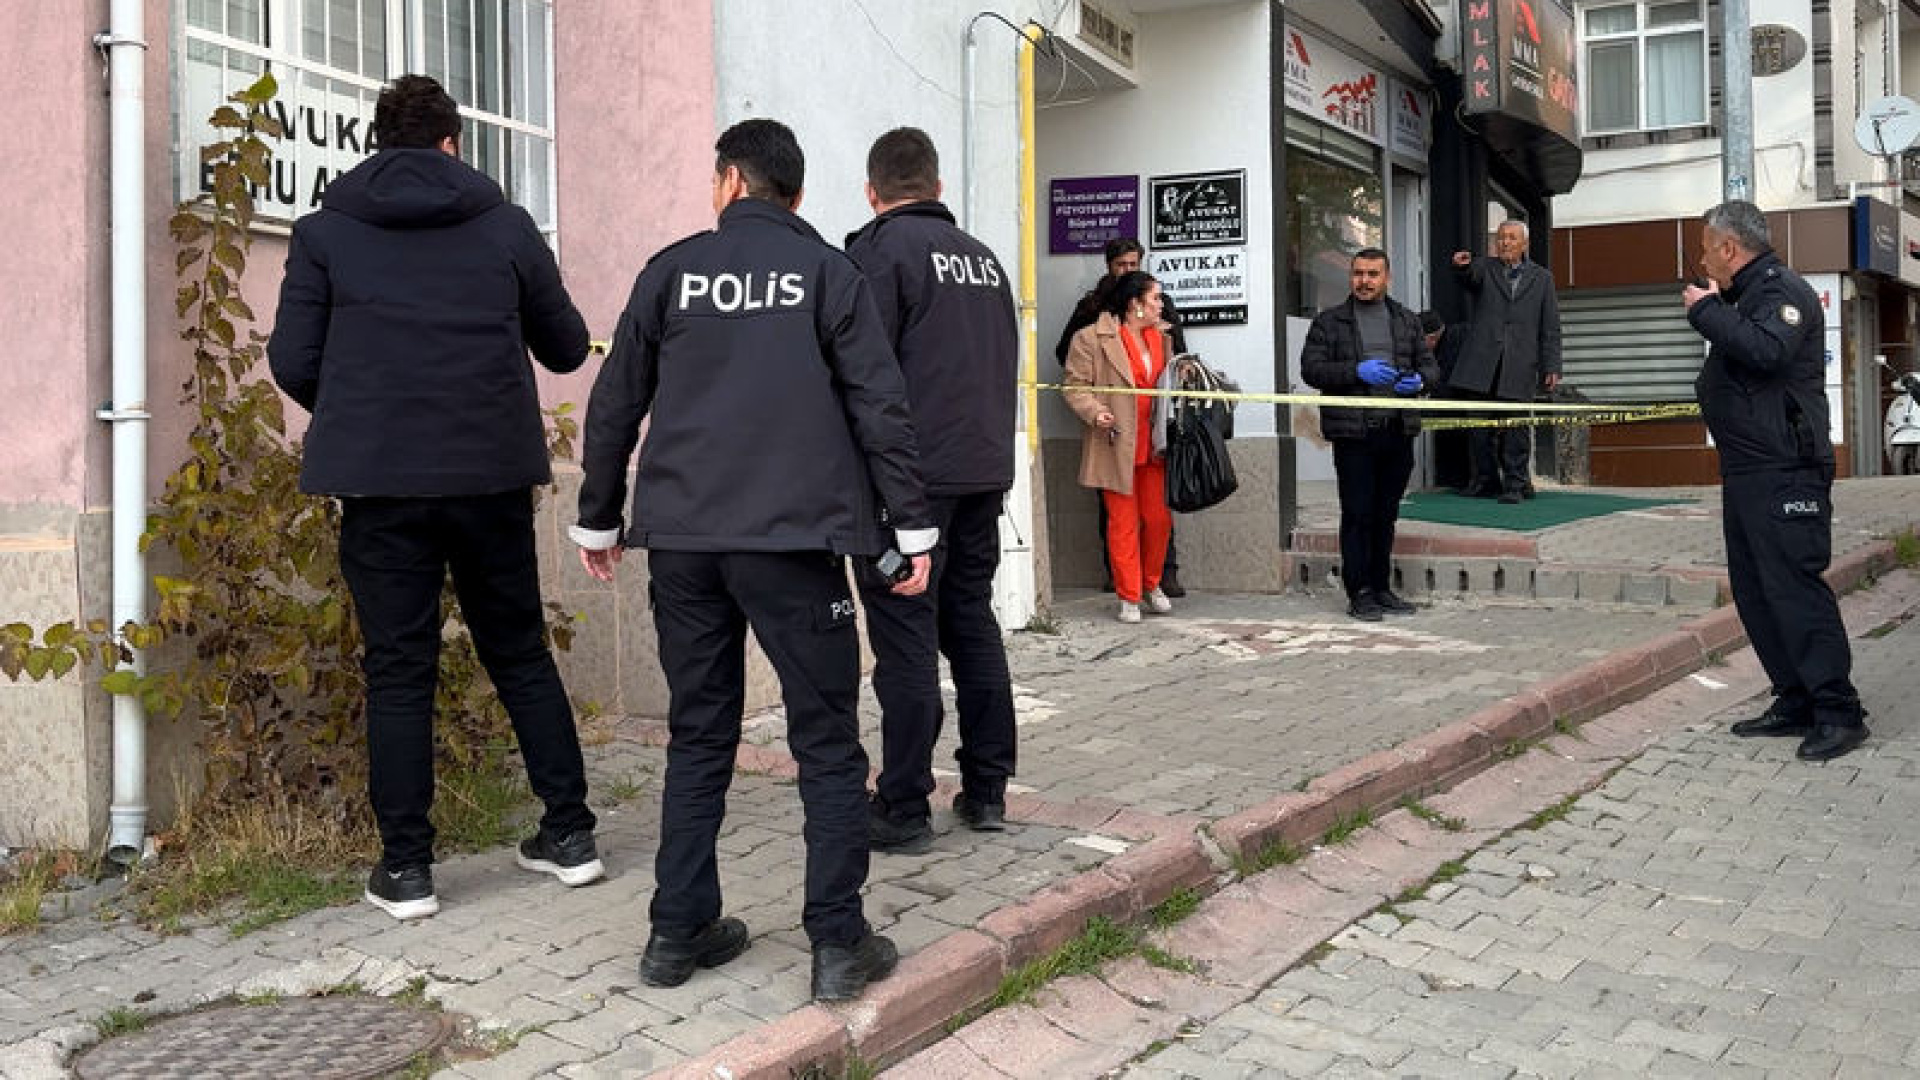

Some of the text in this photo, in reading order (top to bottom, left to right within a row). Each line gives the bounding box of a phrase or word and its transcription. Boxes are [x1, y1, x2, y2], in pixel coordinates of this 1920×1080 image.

[248, 101, 380, 155] VUKA
[1187, 206, 1237, 217] AVUKAT
[1157, 253, 1239, 271] AVUKAT
